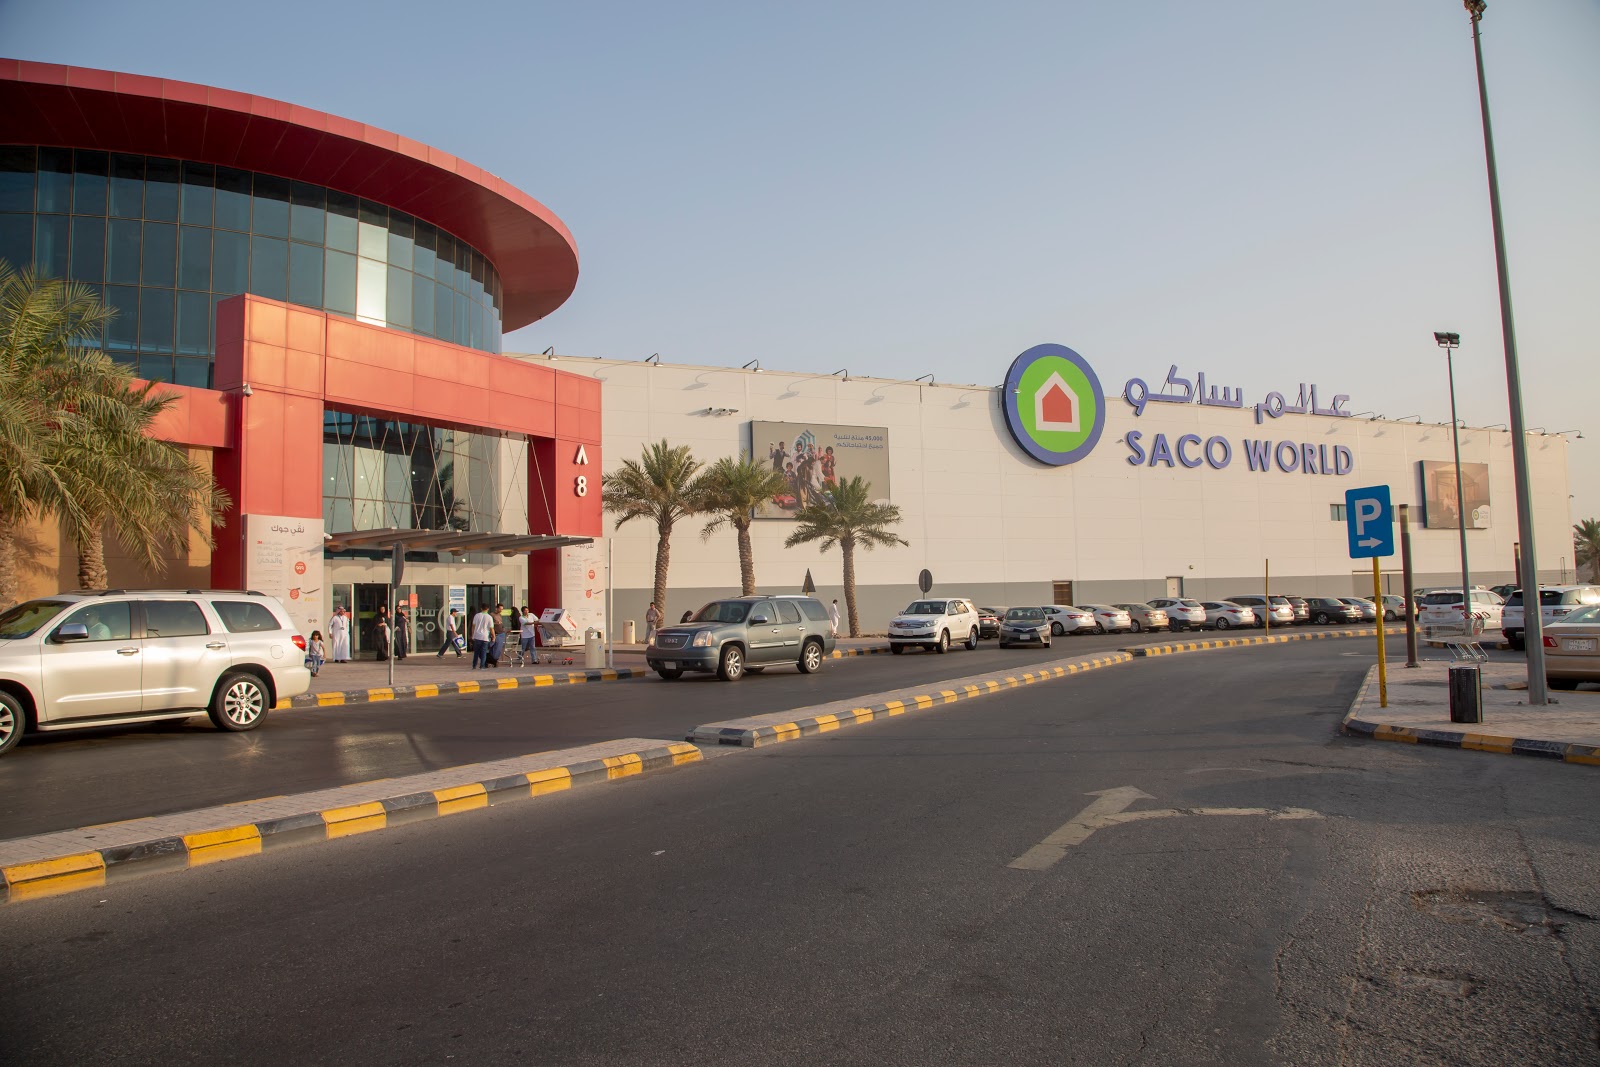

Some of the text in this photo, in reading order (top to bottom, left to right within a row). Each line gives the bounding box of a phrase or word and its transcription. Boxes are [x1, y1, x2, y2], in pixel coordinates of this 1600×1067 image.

[1125, 364, 1350, 424] عالم ساكو
[1126, 430, 1354, 475] SACO WORLD
[574, 475, 588, 498] 8
[1354, 498, 1382, 536] P
